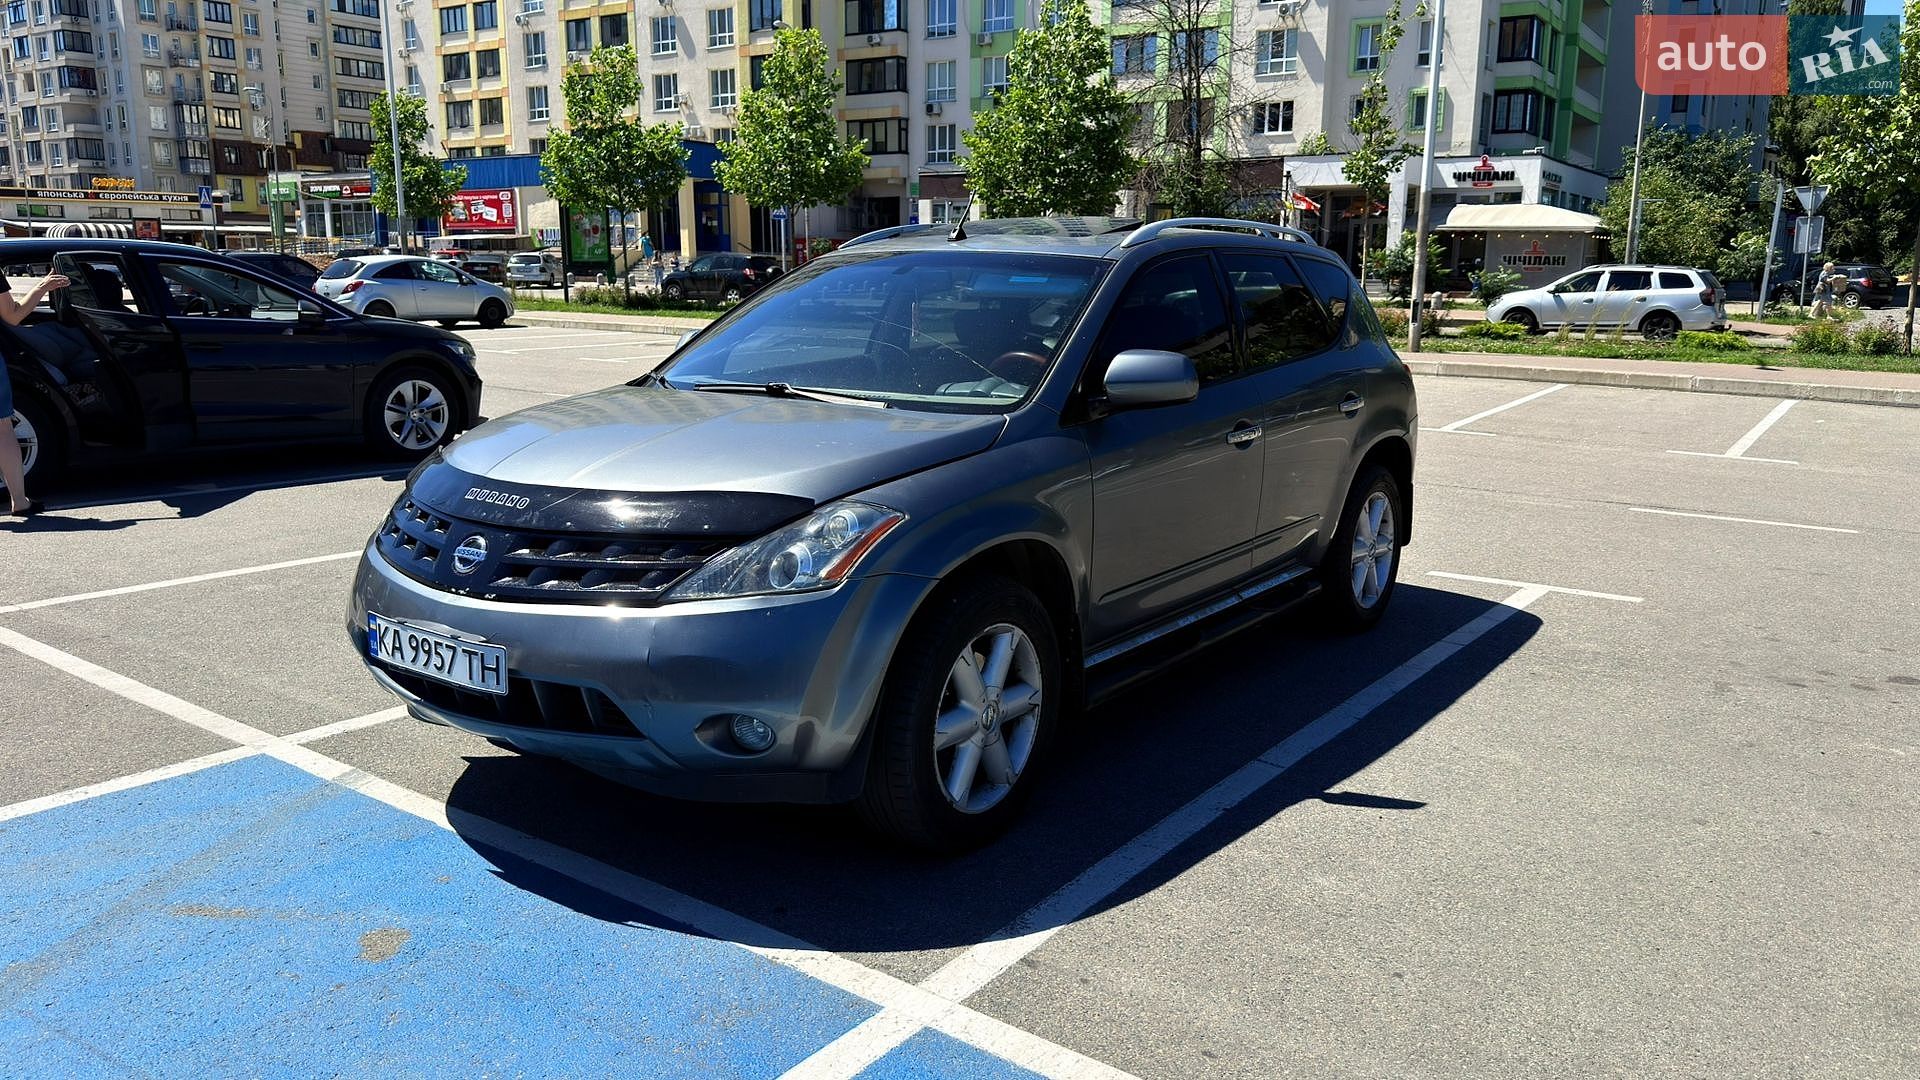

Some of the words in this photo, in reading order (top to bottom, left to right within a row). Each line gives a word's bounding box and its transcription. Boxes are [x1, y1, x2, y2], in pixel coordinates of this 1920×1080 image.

[37, 191, 85, 199] японська
[99, 192, 160, 202] європейська
[162, 195, 189, 203] кухня
[1502, 255, 1567, 266] ЧІЧІЛАКІ
[464, 487, 530, 510] MURANO
[457, 548, 482, 558] NISSAN
[377, 622, 405, 661] KA
[408, 633, 457, 675] 9957
[461, 647, 500, 686] TH
